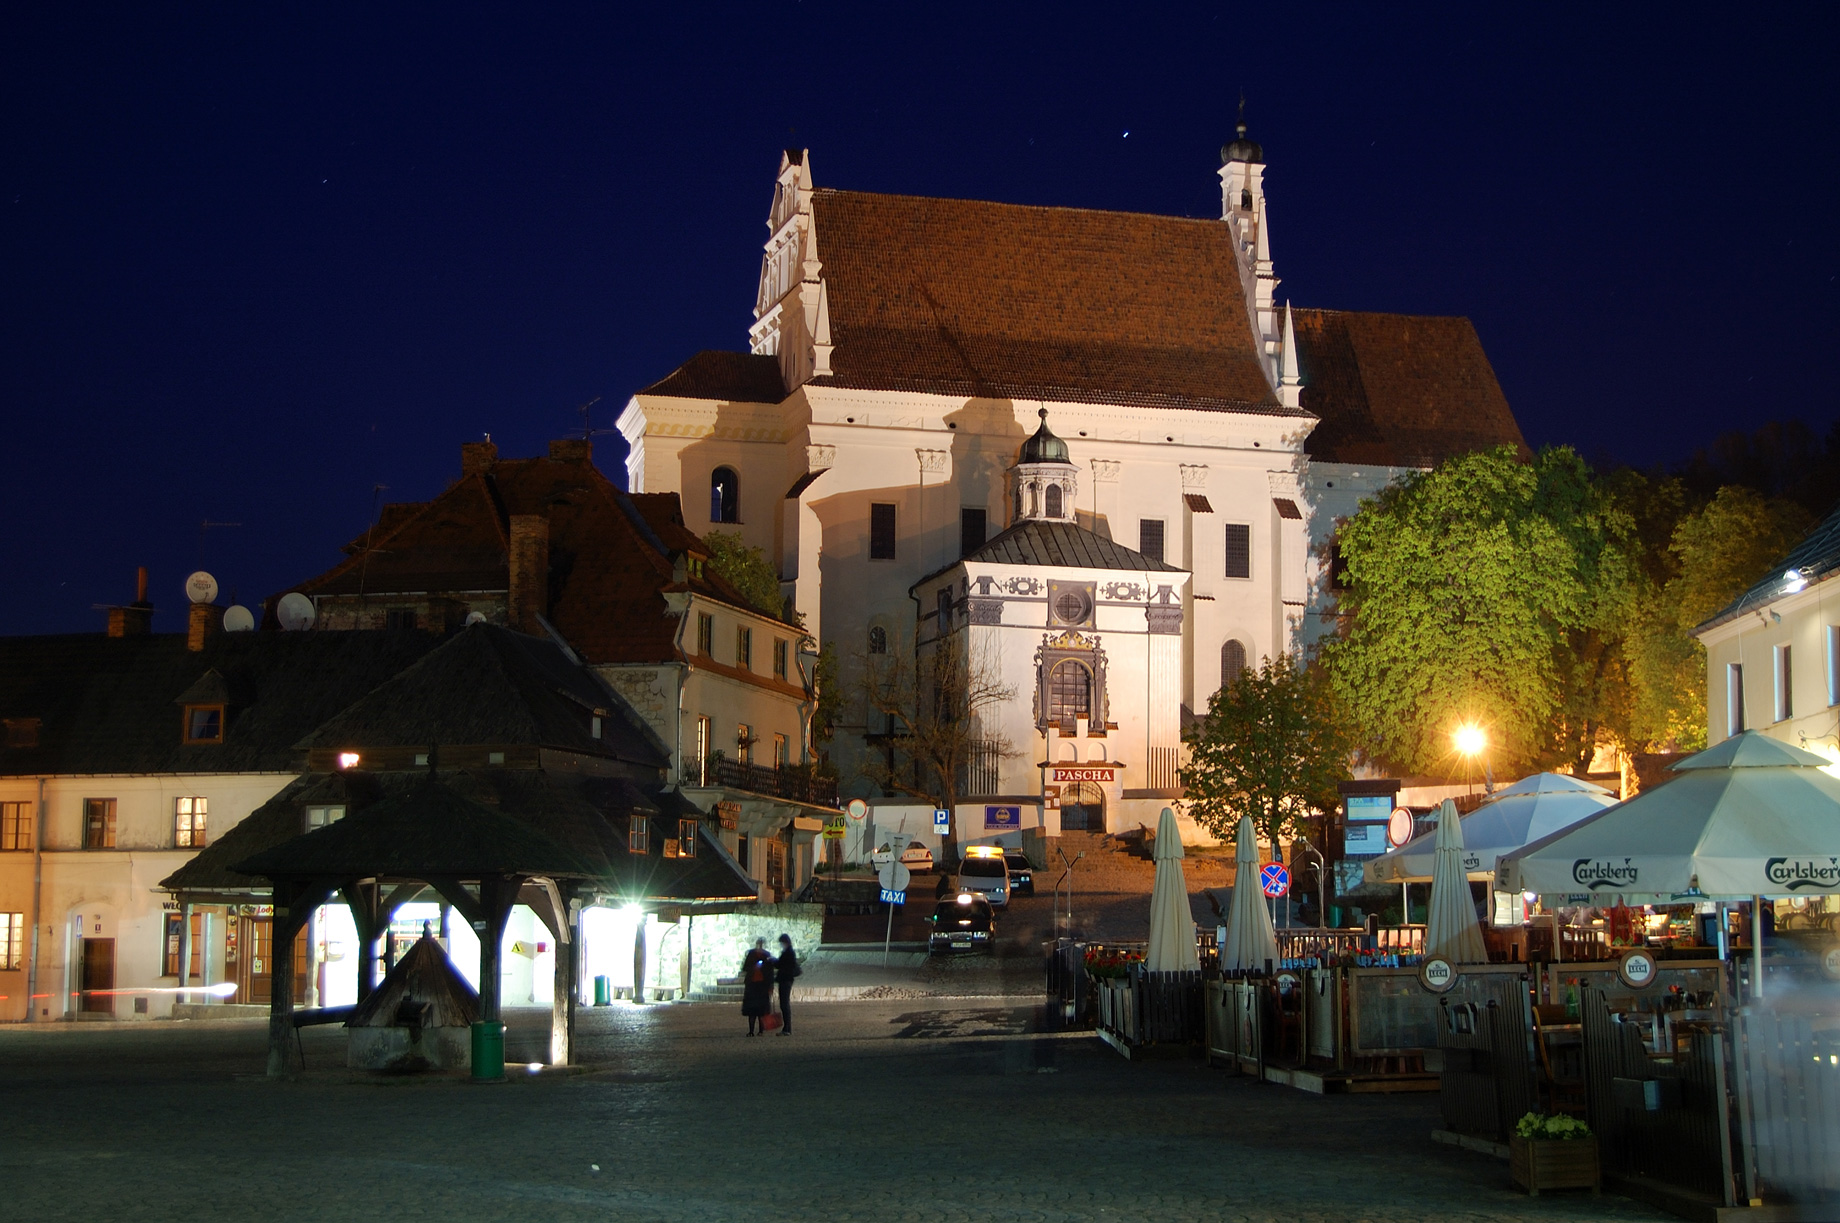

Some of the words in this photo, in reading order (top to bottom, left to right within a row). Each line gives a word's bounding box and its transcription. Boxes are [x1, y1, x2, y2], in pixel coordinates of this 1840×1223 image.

[1056, 770, 1112, 780] PASCHA
[937, 811, 946, 824] P
[1573, 858, 1639, 886] Carlsberg
[881, 889, 905, 903] TAXI
[256, 904, 273, 915] Lody
